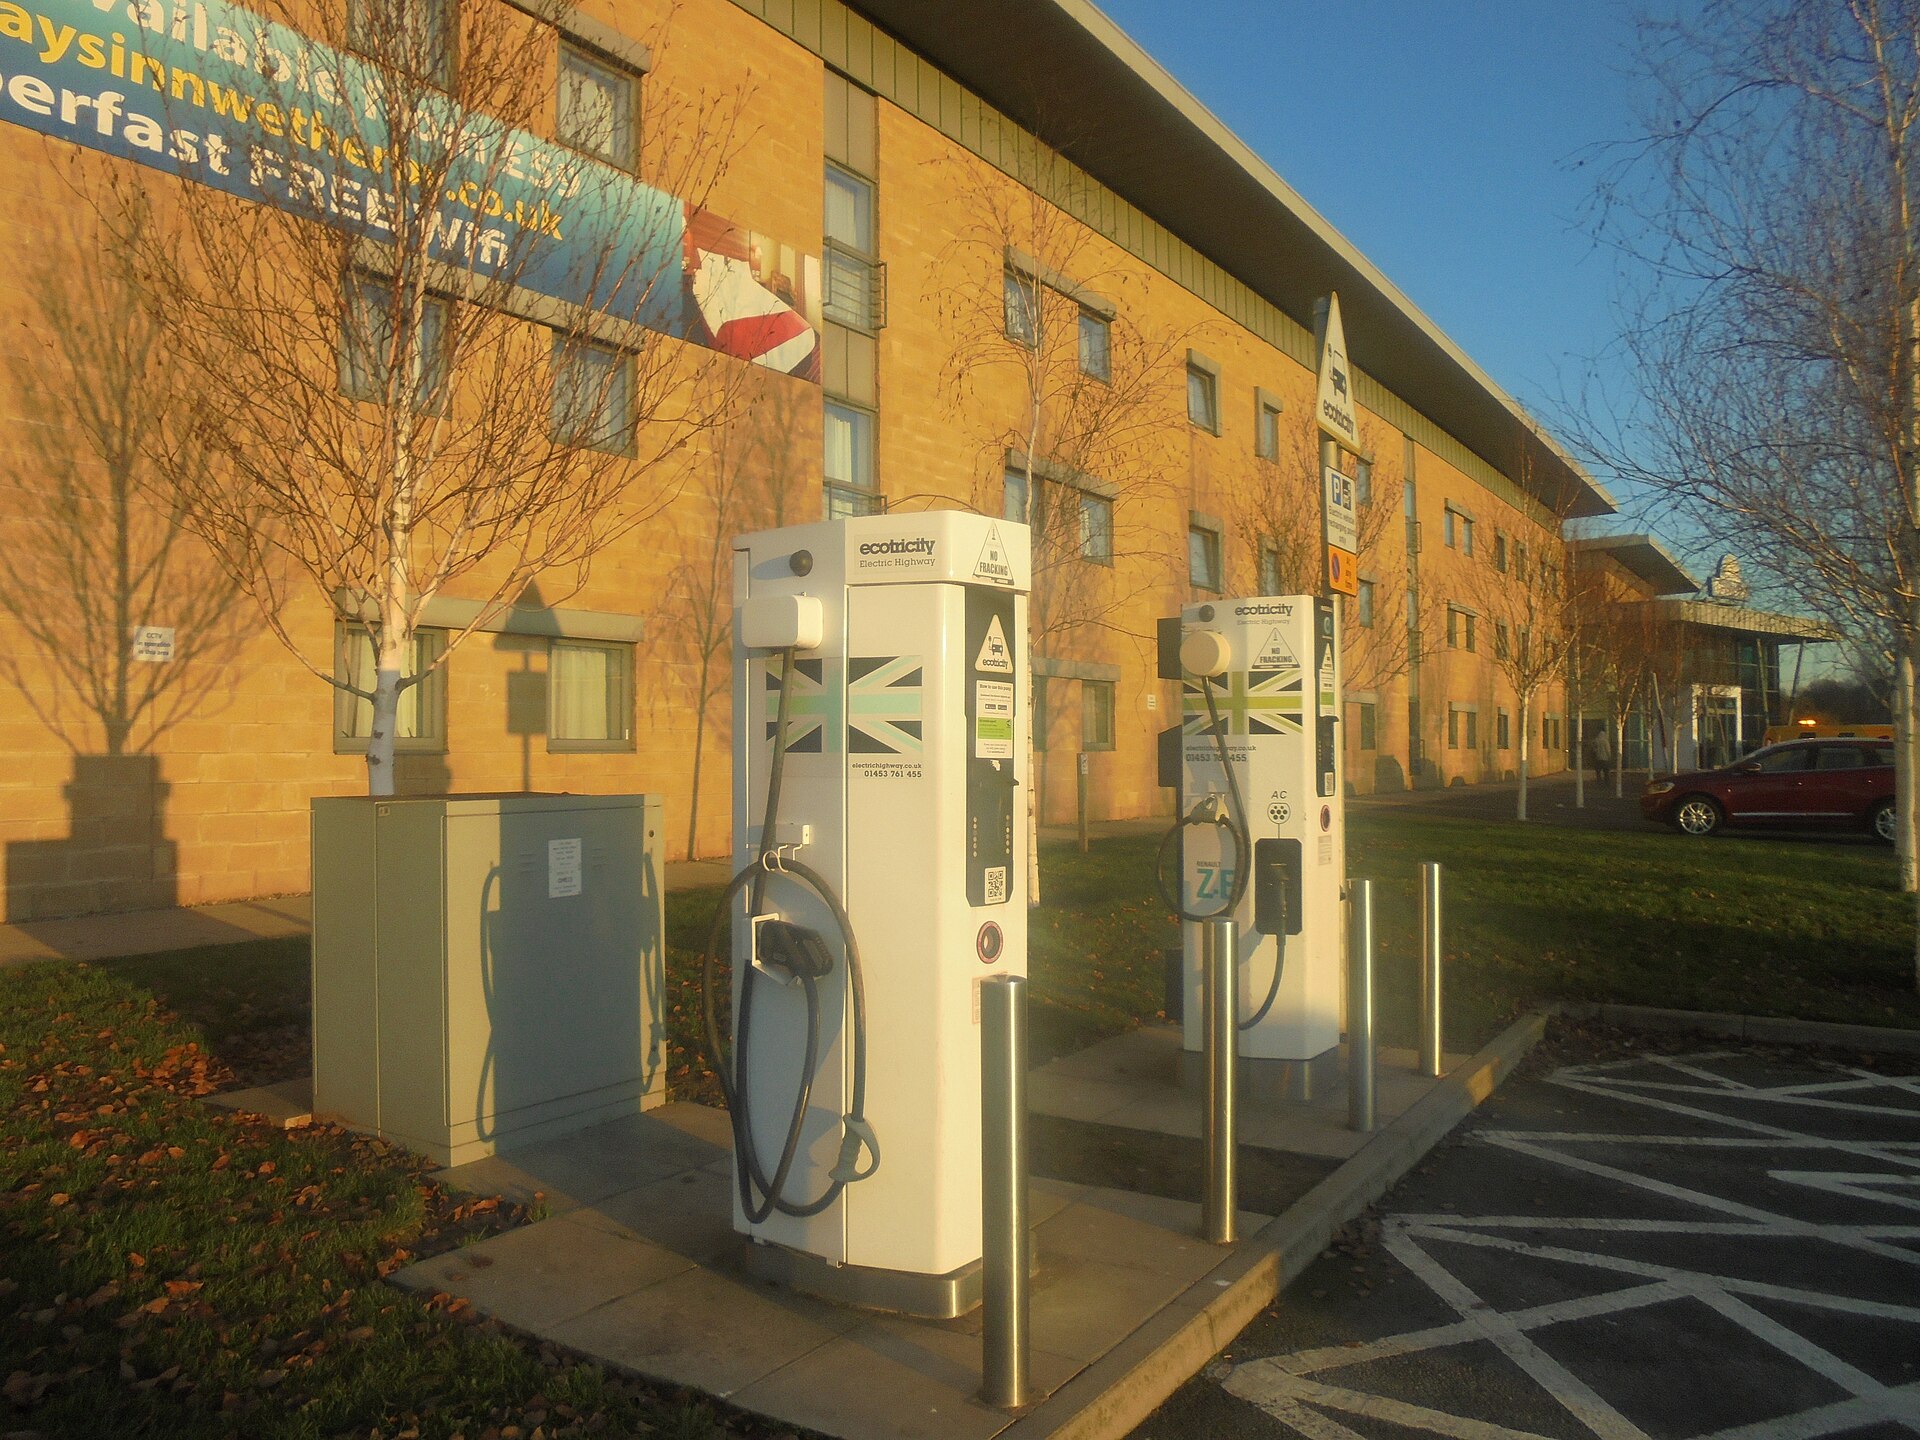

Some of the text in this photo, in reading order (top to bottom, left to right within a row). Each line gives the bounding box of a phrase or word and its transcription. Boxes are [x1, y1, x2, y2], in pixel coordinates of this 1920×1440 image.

[0, 70, 232, 177] erfast
[859, 537, 936, 556] ecotricity
[989, 550, 998, 562] NO
[859, 557, 936, 568] Electric Highway
[979, 561, 1009, 576] FRACKING
[1234, 603, 1294, 617] ecotricity
[1271, 647, 1281, 655] NO
[982, 657, 1009, 670] ecotricity
[1259, 655, 1293, 664] FRACKING
[851, 762, 922, 770] electrichighway.co.uk
[864, 770, 922, 778] 01453 761 455
[1270, 790, 1288, 800] AC
